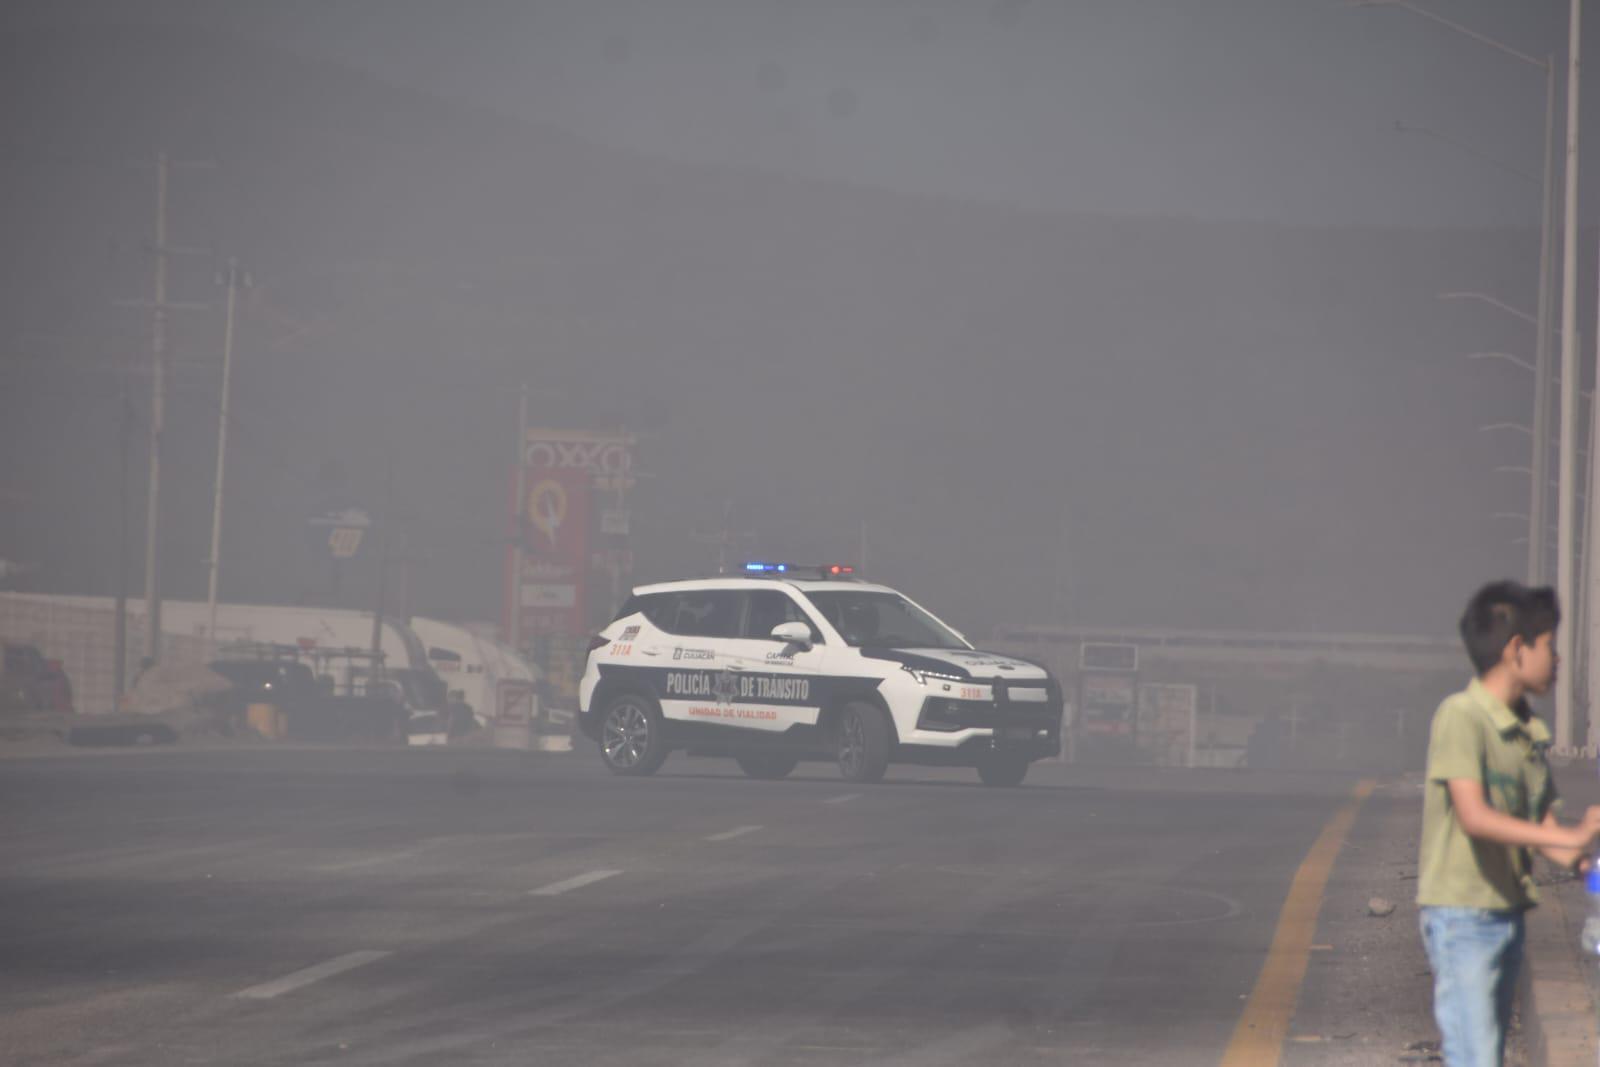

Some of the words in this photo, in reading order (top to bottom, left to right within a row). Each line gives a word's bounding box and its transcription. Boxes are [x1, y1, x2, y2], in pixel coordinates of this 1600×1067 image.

[667, 671, 710, 695] POLICÍA
[741, 676, 754, 697] DE
[757, 674, 809, 700] TRÁNSITO
[688, 706, 721, 716] UNIDAD
[723, 708, 733, 718] DE
[736, 708, 777, 720] VIALIDAD
